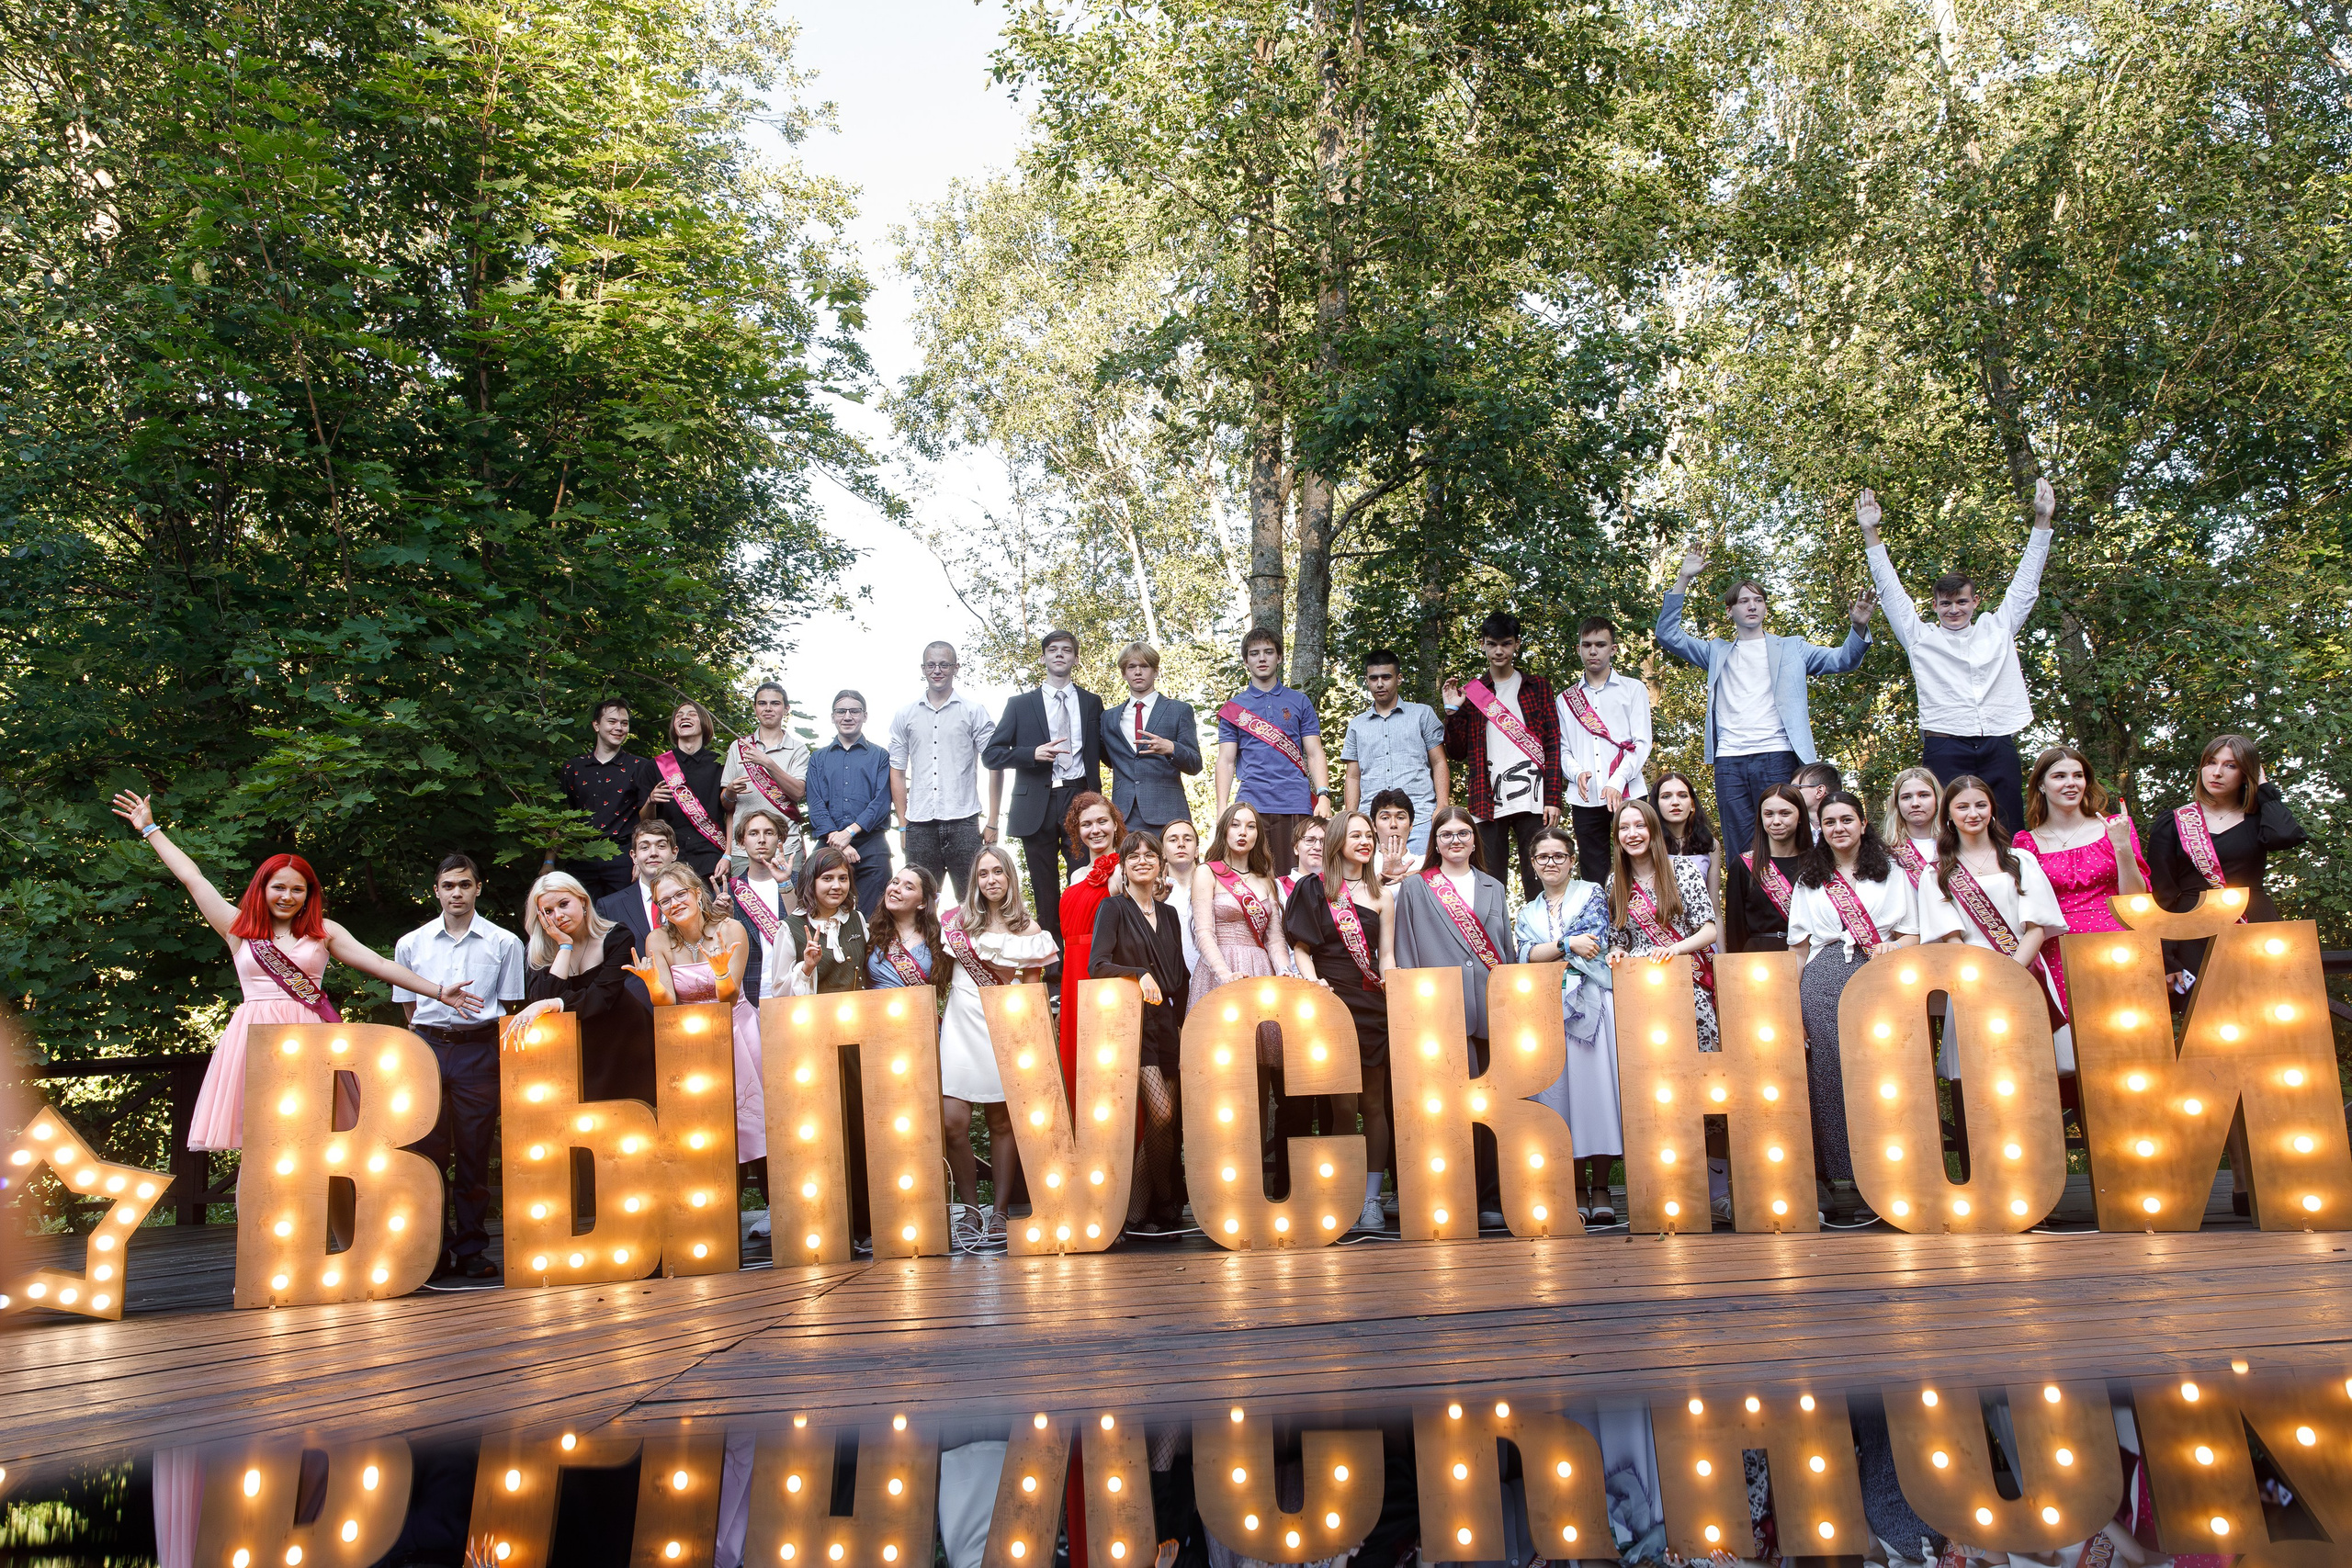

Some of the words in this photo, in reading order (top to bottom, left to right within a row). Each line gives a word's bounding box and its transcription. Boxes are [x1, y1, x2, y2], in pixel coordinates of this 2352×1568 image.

[711, 830, 727, 850] 202
[733, 886, 777, 937] Выпускни
[1478, 950, 1499, 970] 20
[283, 971, 322, 1005] 2024
[233, 886, 2352, 1309] ВЫПУСКНОЙ
